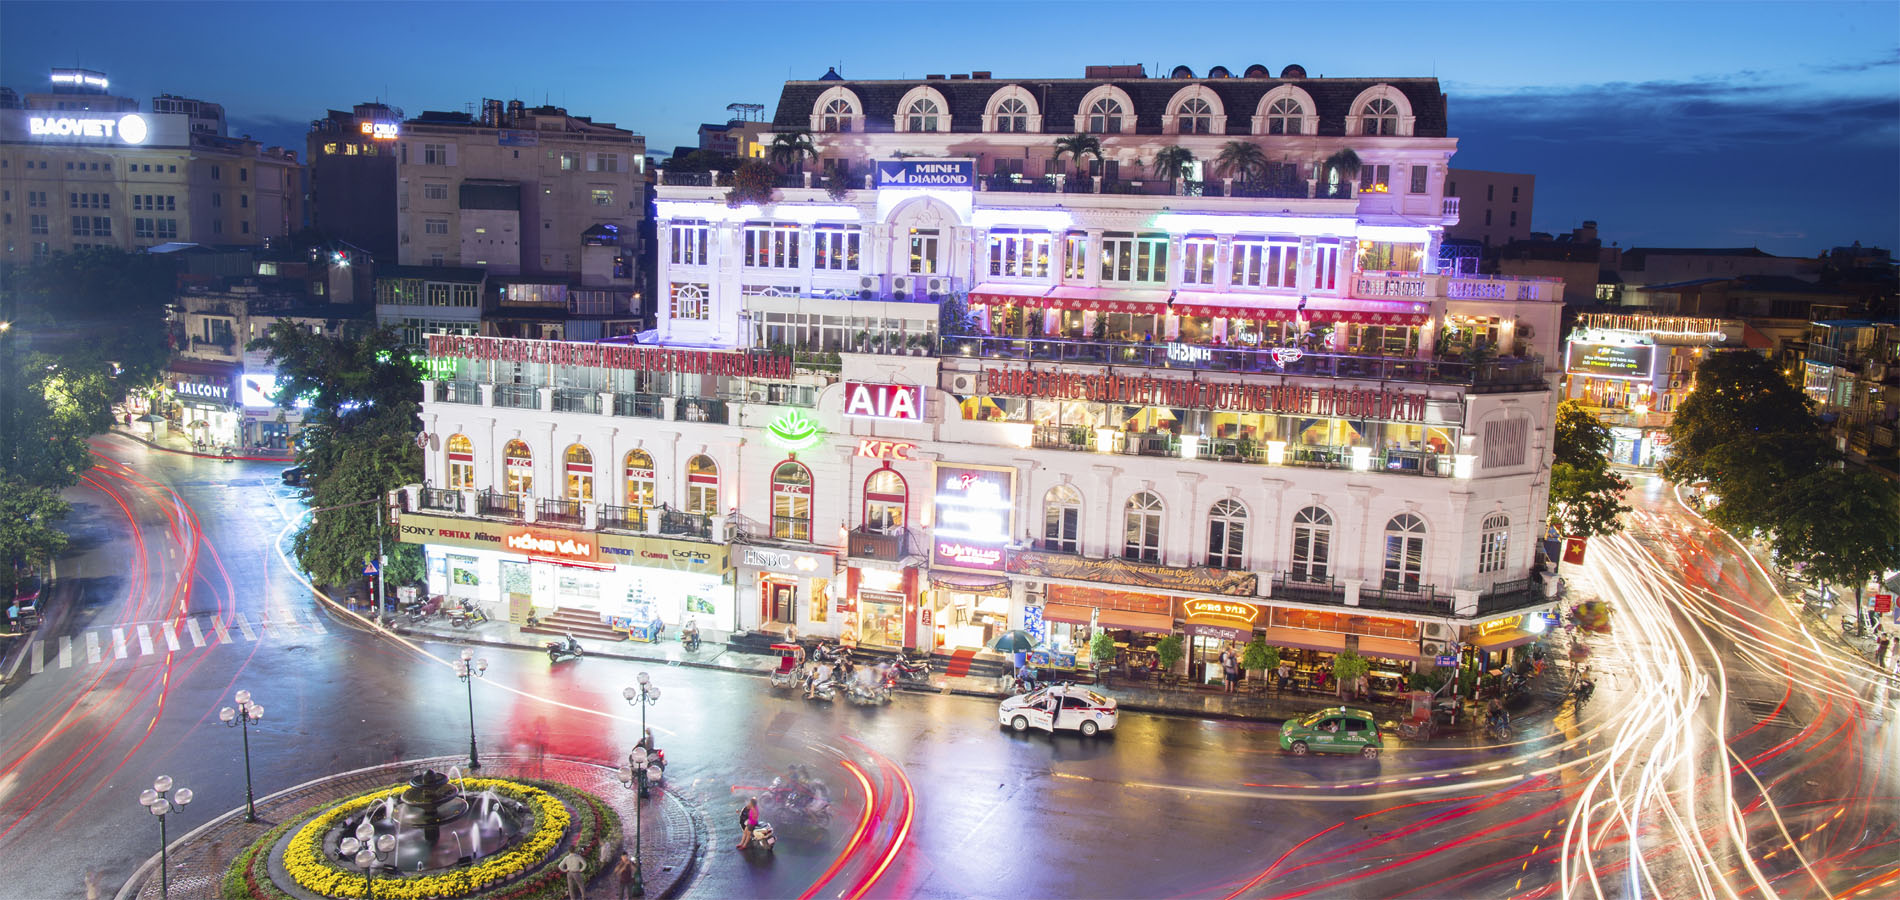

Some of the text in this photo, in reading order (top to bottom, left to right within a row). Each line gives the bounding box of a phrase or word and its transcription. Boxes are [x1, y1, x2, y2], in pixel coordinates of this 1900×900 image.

[916, 164, 960, 173] MINH
[909, 174, 967, 184] DIAMOND
[676, 349, 707, 375] NAM
[758, 352, 790, 380] NĂM
[179, 382, 228, 398] BALCONY
[848, 386, 917, 419] AIA
[1160, 379, 1200, 408] NAM
[1205, 382, 1267, 411] QUANG
[1271, 385, 1312, 414] VINH
[1318, 384, 1375, 419] MUÔN
[1380, 387, 1426, 421] NĂM
[857, 440, 909, 460] KFC
[511, 459, 530, 467] KFC
[631, 470, 651, 478] KFC
[783, 485, 803, 493] KFC
[401, 525, 501, 542] SONY PENTAX Nikon
[600, 546, 711, 560] TAMRON Canon GoPro
[743, 549, 790, 569] HSBC
